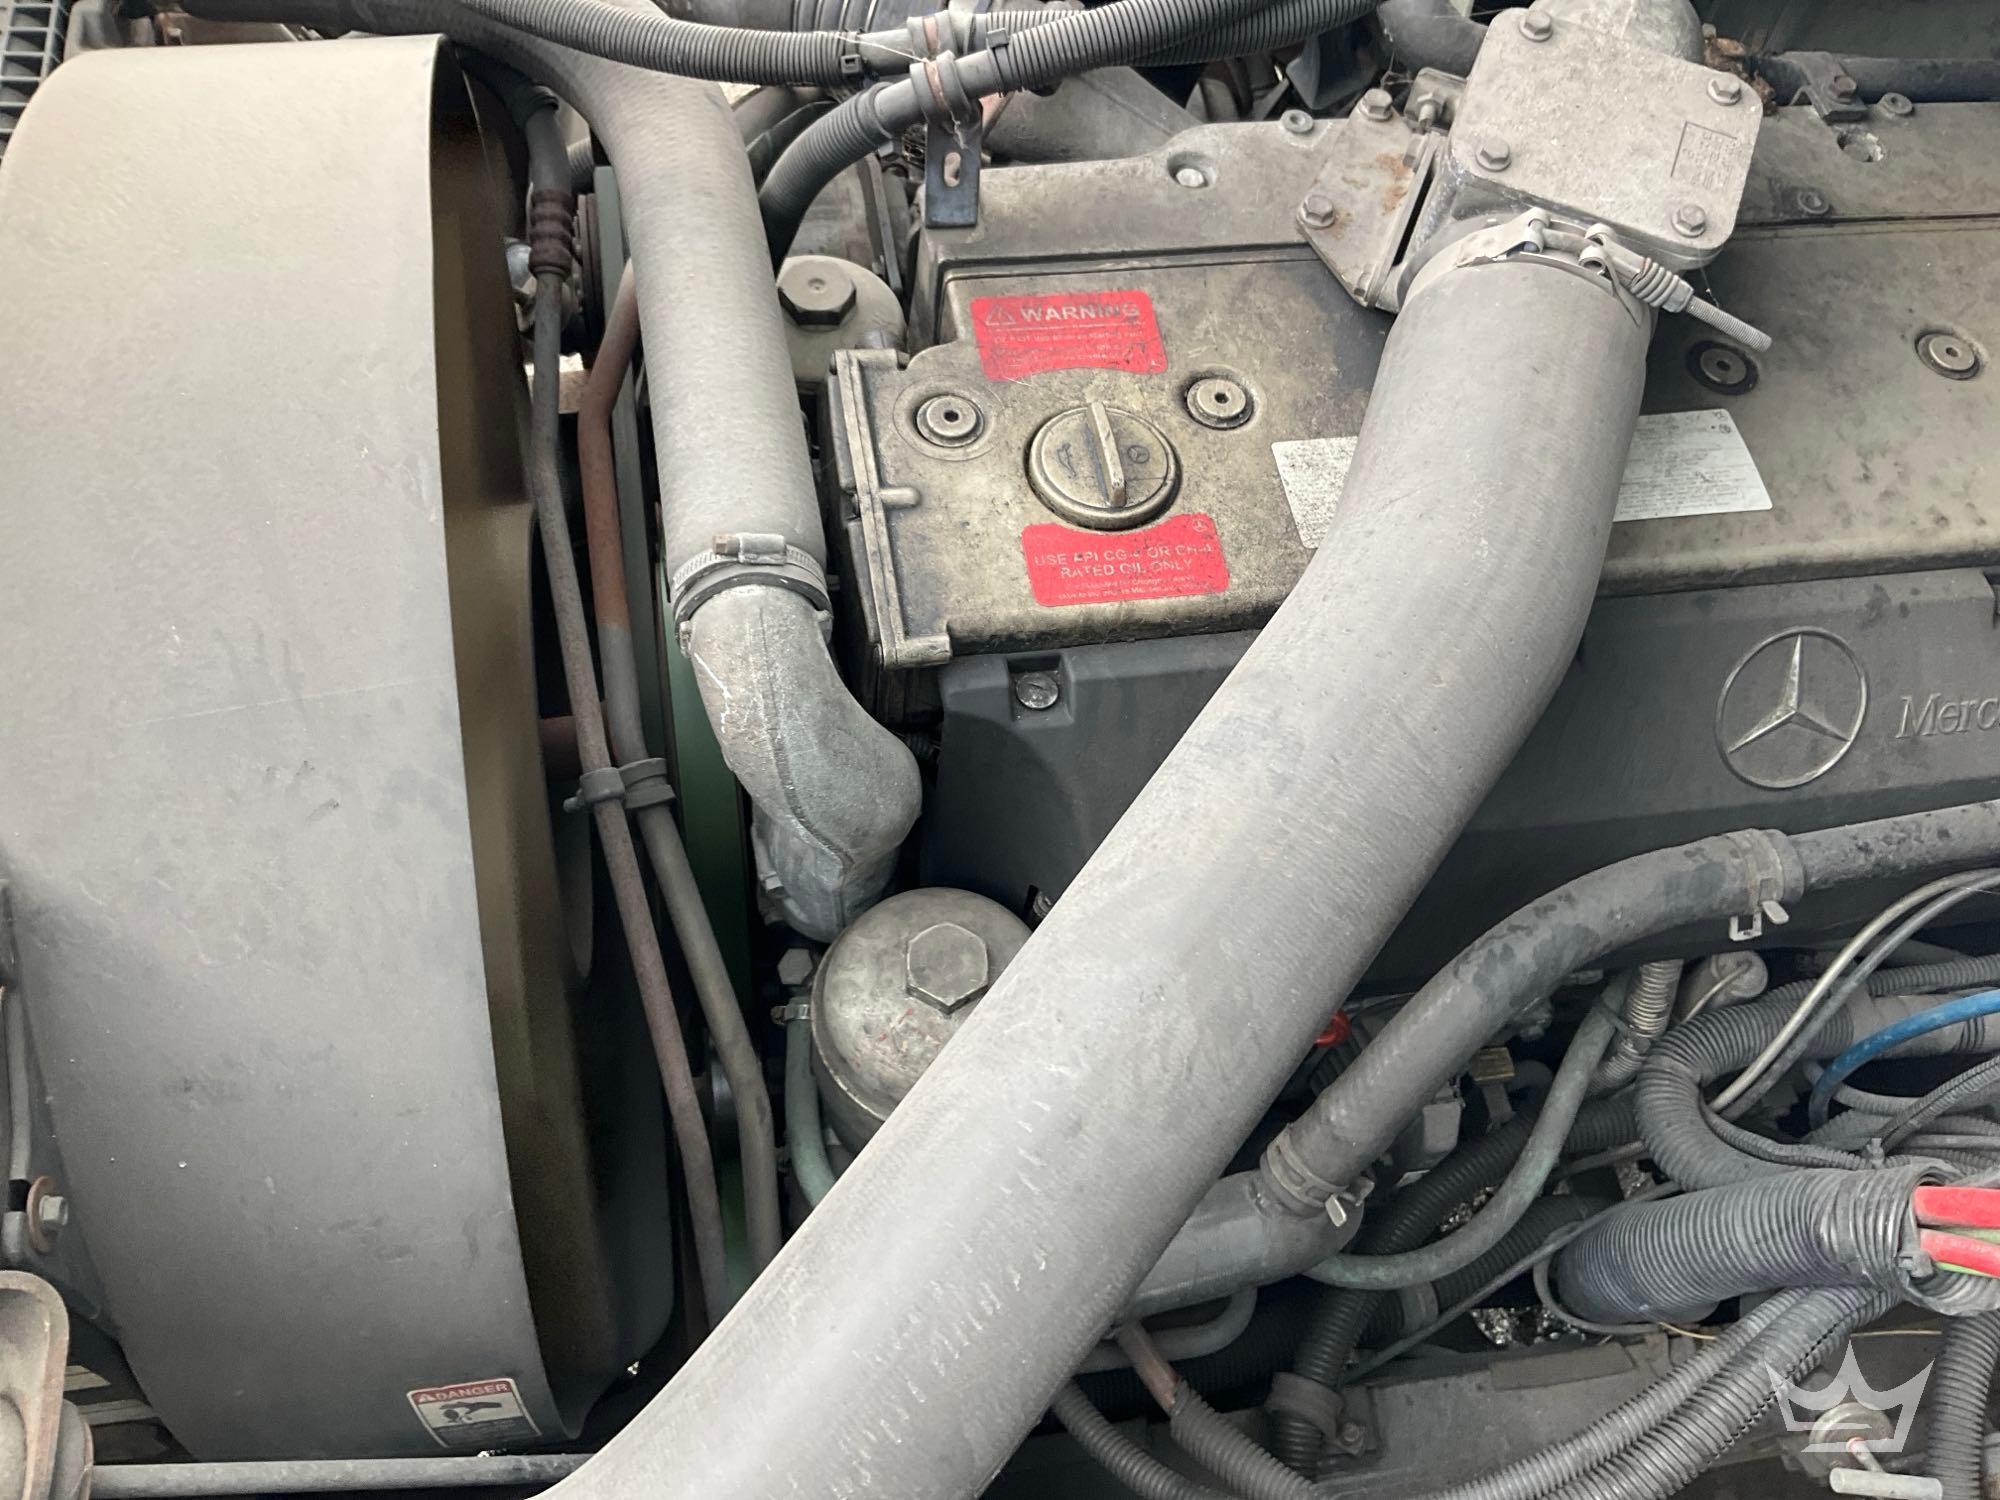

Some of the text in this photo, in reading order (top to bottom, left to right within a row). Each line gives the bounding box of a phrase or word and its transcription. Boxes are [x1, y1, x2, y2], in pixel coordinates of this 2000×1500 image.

[1019, 302, 1142, 322] WARNING
[1034, 553, 1068, 566] USE
[1147, 546, 1172, 558] OR
[1060, 558, 1193, 579] RATED OIL ONLY
[435, 1383, 508, 1400] DANGER
